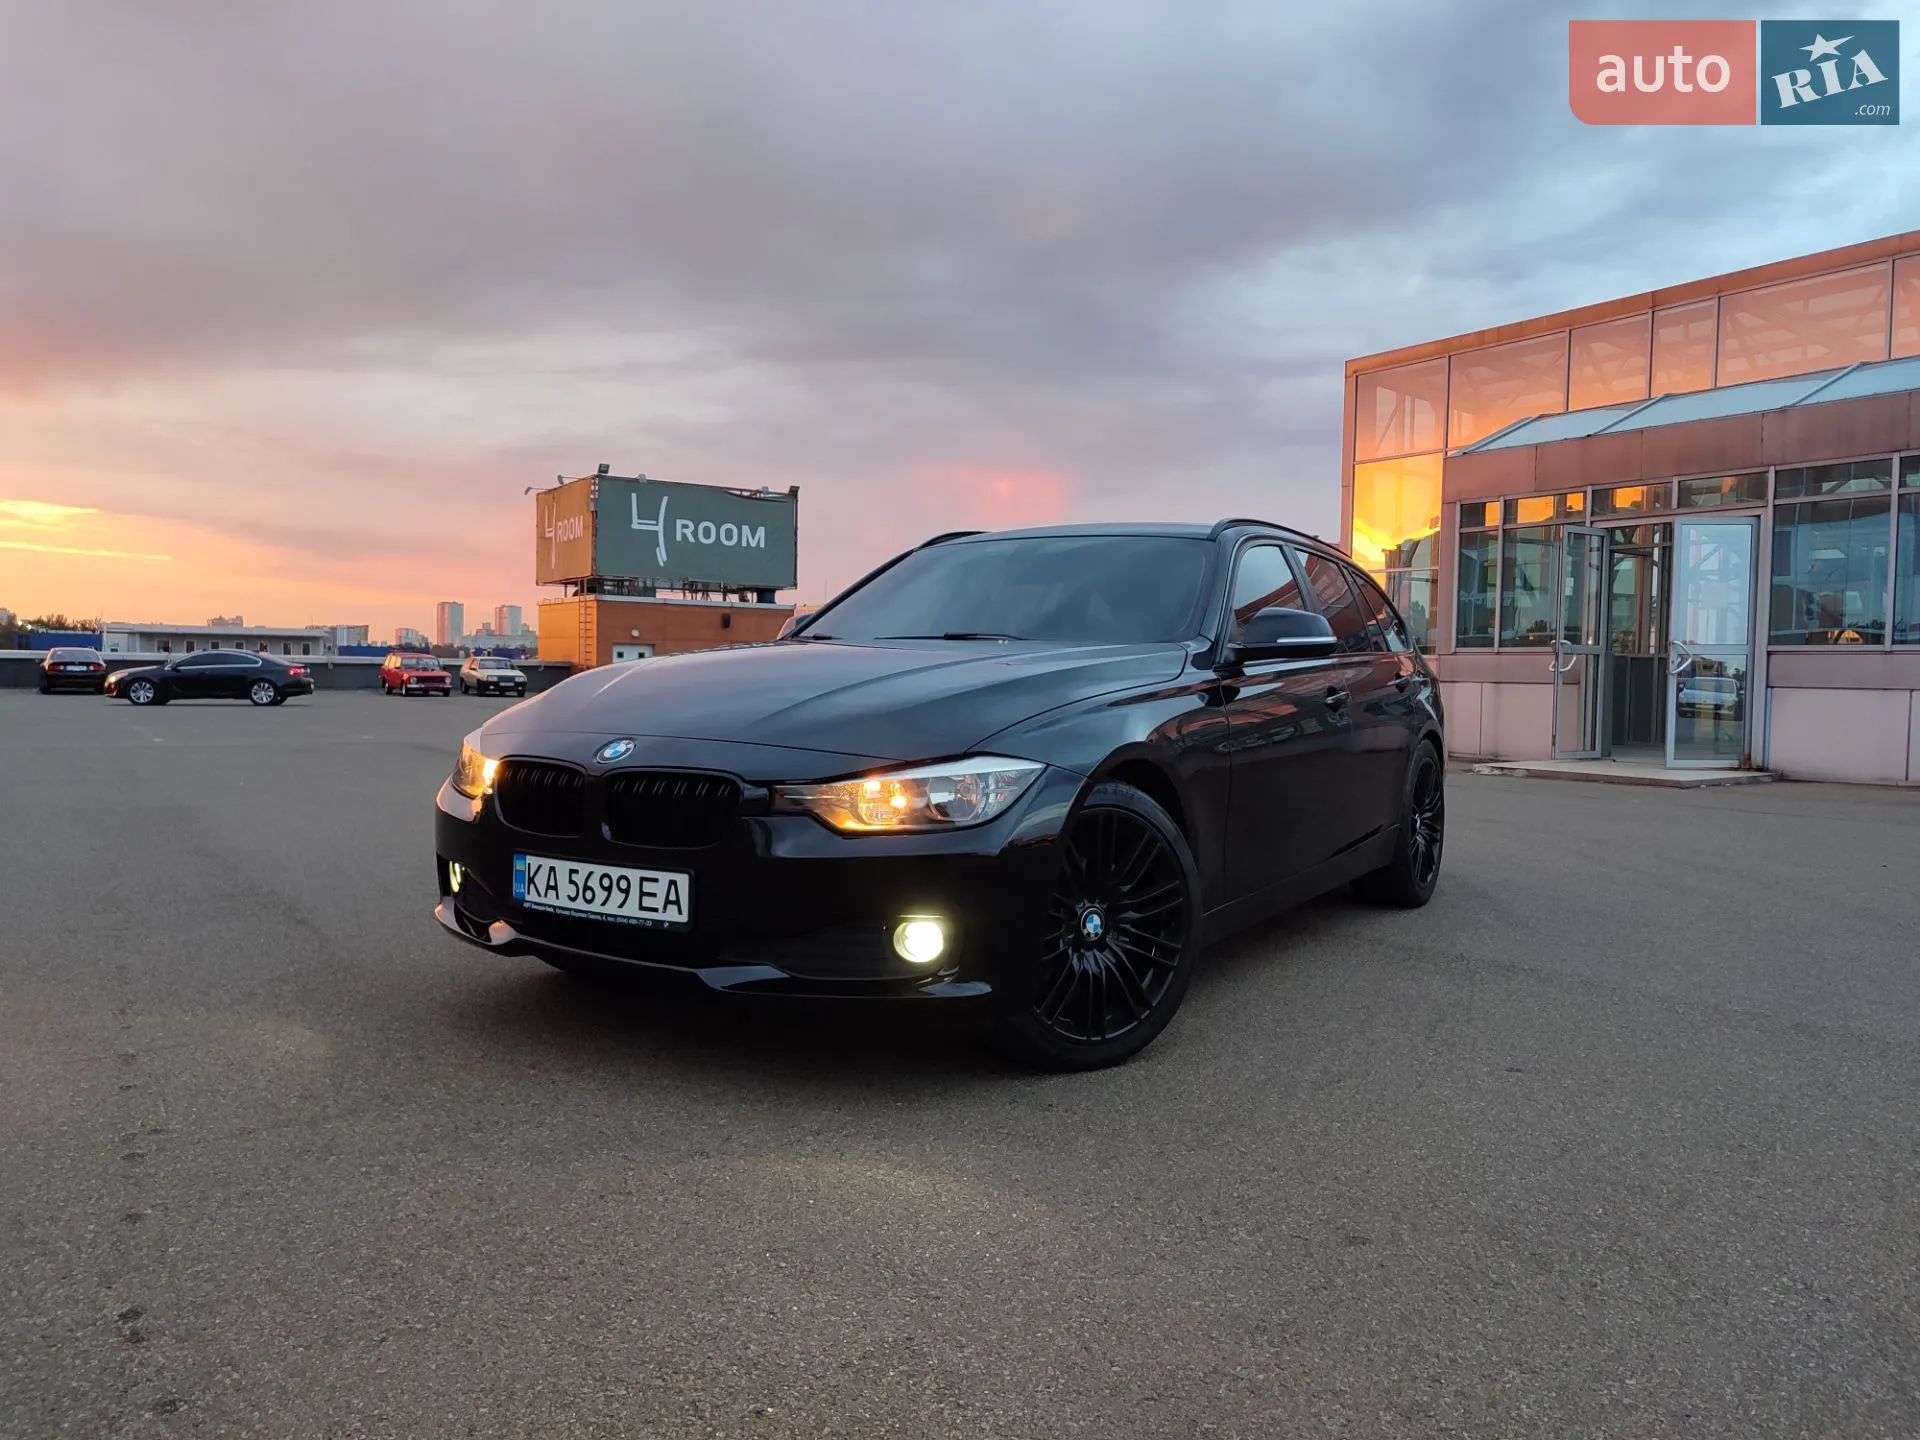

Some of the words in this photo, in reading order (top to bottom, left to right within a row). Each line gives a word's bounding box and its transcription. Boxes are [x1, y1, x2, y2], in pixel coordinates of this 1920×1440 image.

[557, 515, 584, 543] ROOM
[675, 518, 766, 549] ROOM
[515, 882, 524, 893] UA
[526, 862, 560, 900] KA
[566, 868, 632, 909] 5699
[638, 876, 683, 915] EA
